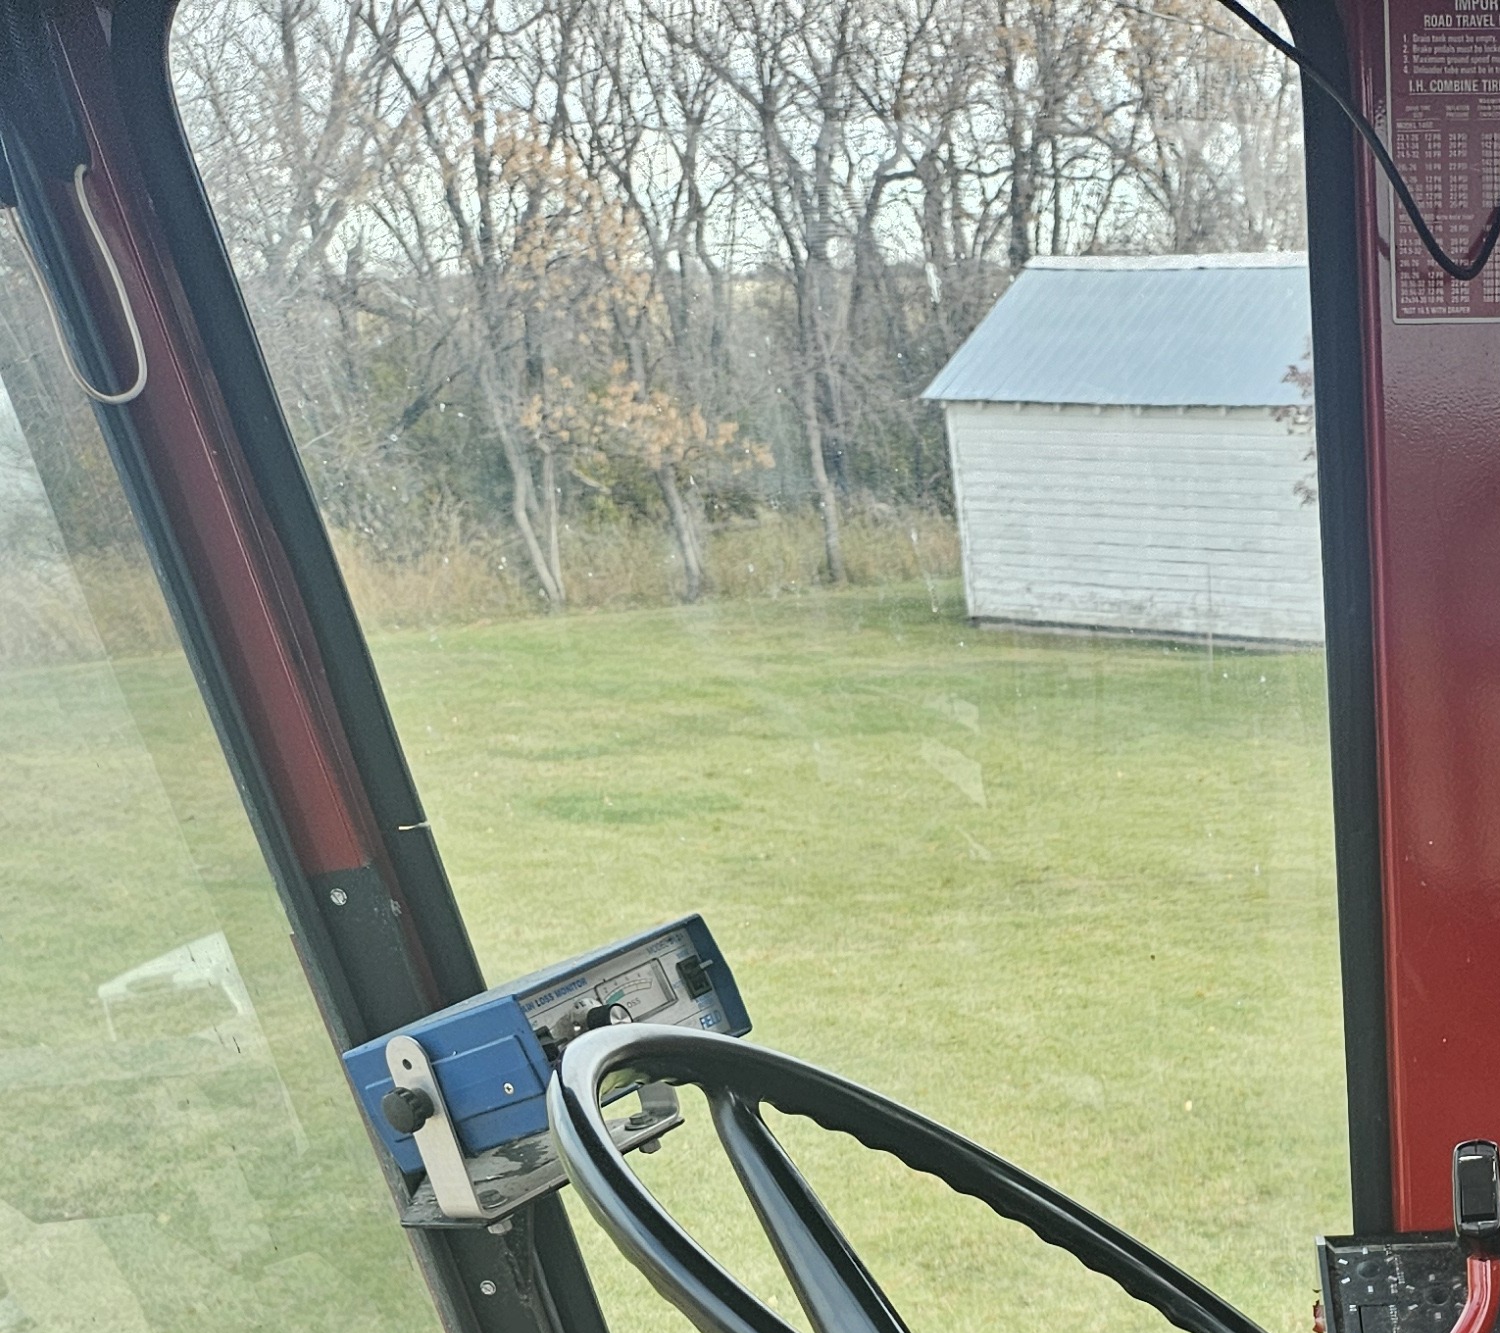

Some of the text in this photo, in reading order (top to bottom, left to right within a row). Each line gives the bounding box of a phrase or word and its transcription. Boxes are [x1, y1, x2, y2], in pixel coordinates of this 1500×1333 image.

[1424, 14, 1453, 27] ROAD
[1456, 14, 1496, 27] TRAVEL
[1409, 80, 1427, 92] I.H.
[1430, 80, 1479, 92] COMBINE
[534, 990, 556, 1008] LOSS
[553, 977, 589, 999] MONITOR
